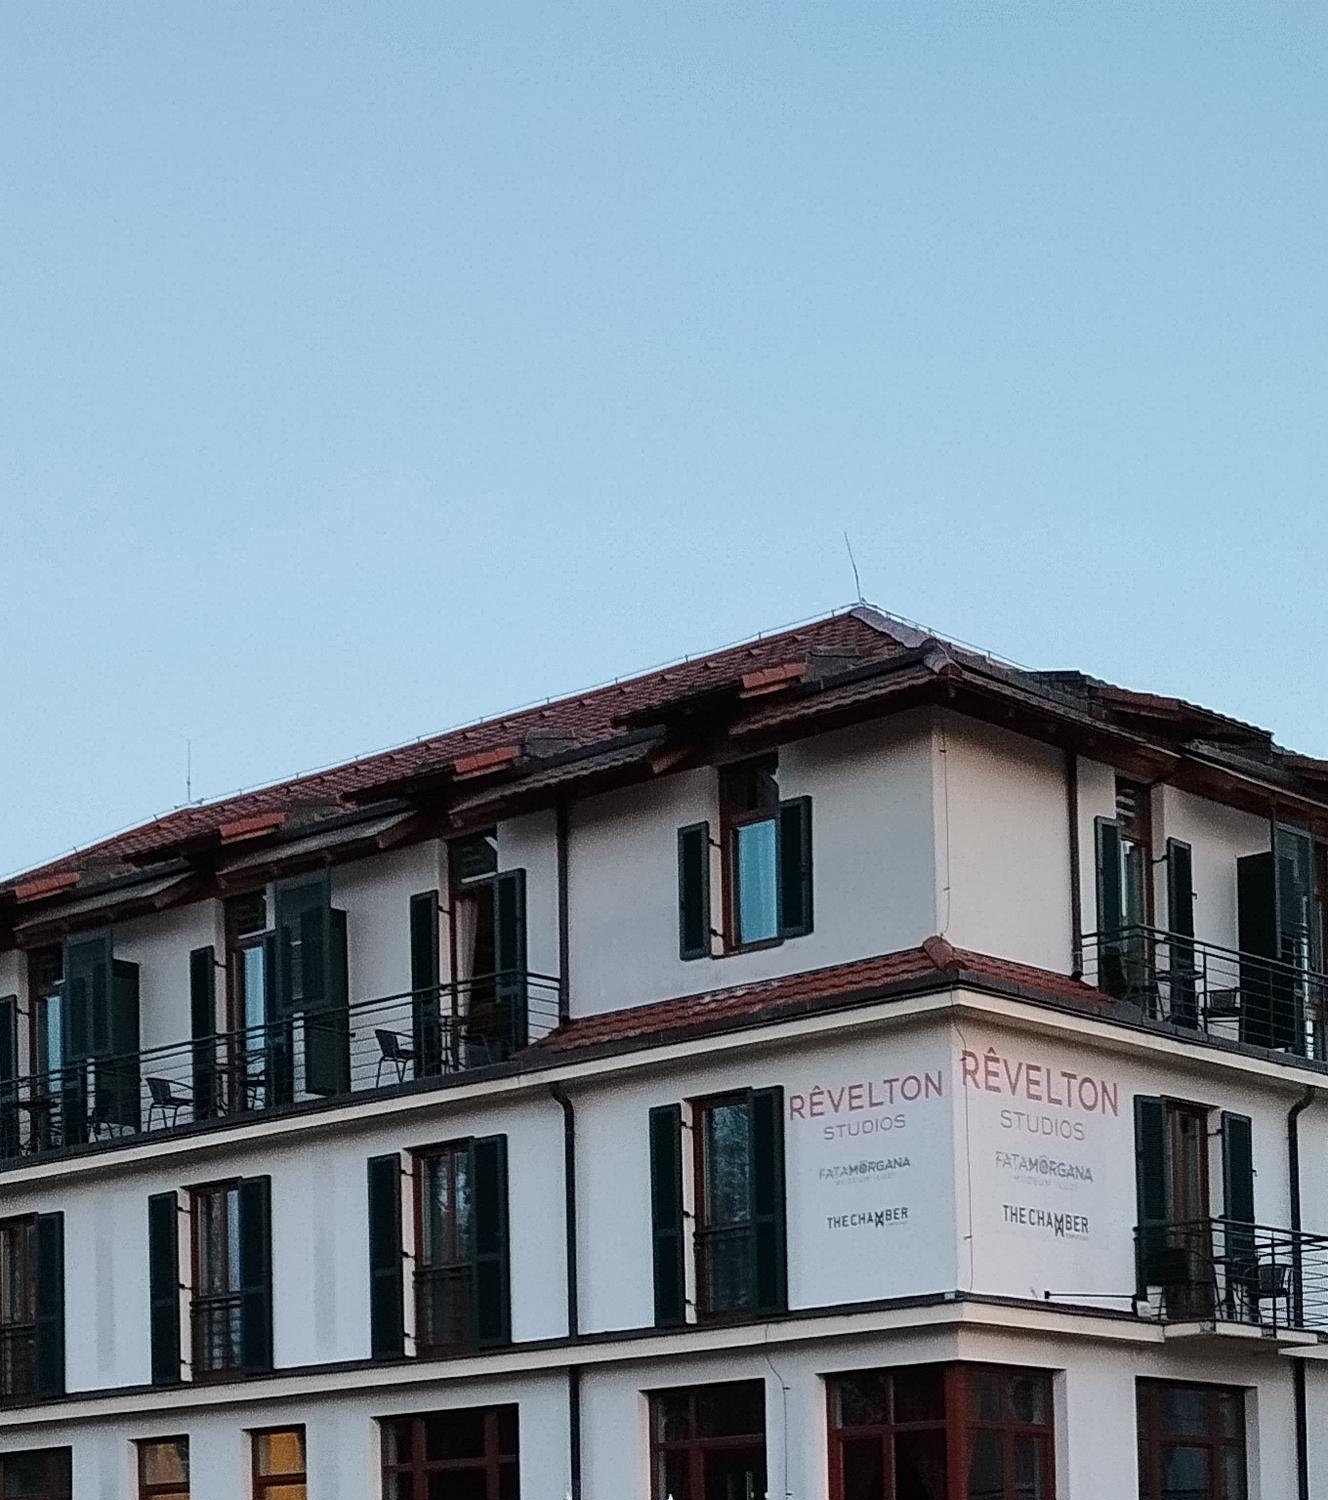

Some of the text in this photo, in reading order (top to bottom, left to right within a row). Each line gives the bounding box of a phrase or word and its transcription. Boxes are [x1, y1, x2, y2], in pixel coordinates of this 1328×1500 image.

[790, 1070, 943, 1121] RÊVELTON
[960, 1046, 1119, 1118] RÊVELTON
[823, 1113, 907, 1141] STUDIOS
[999, 1109, 1086, 1141] STUDIOS
